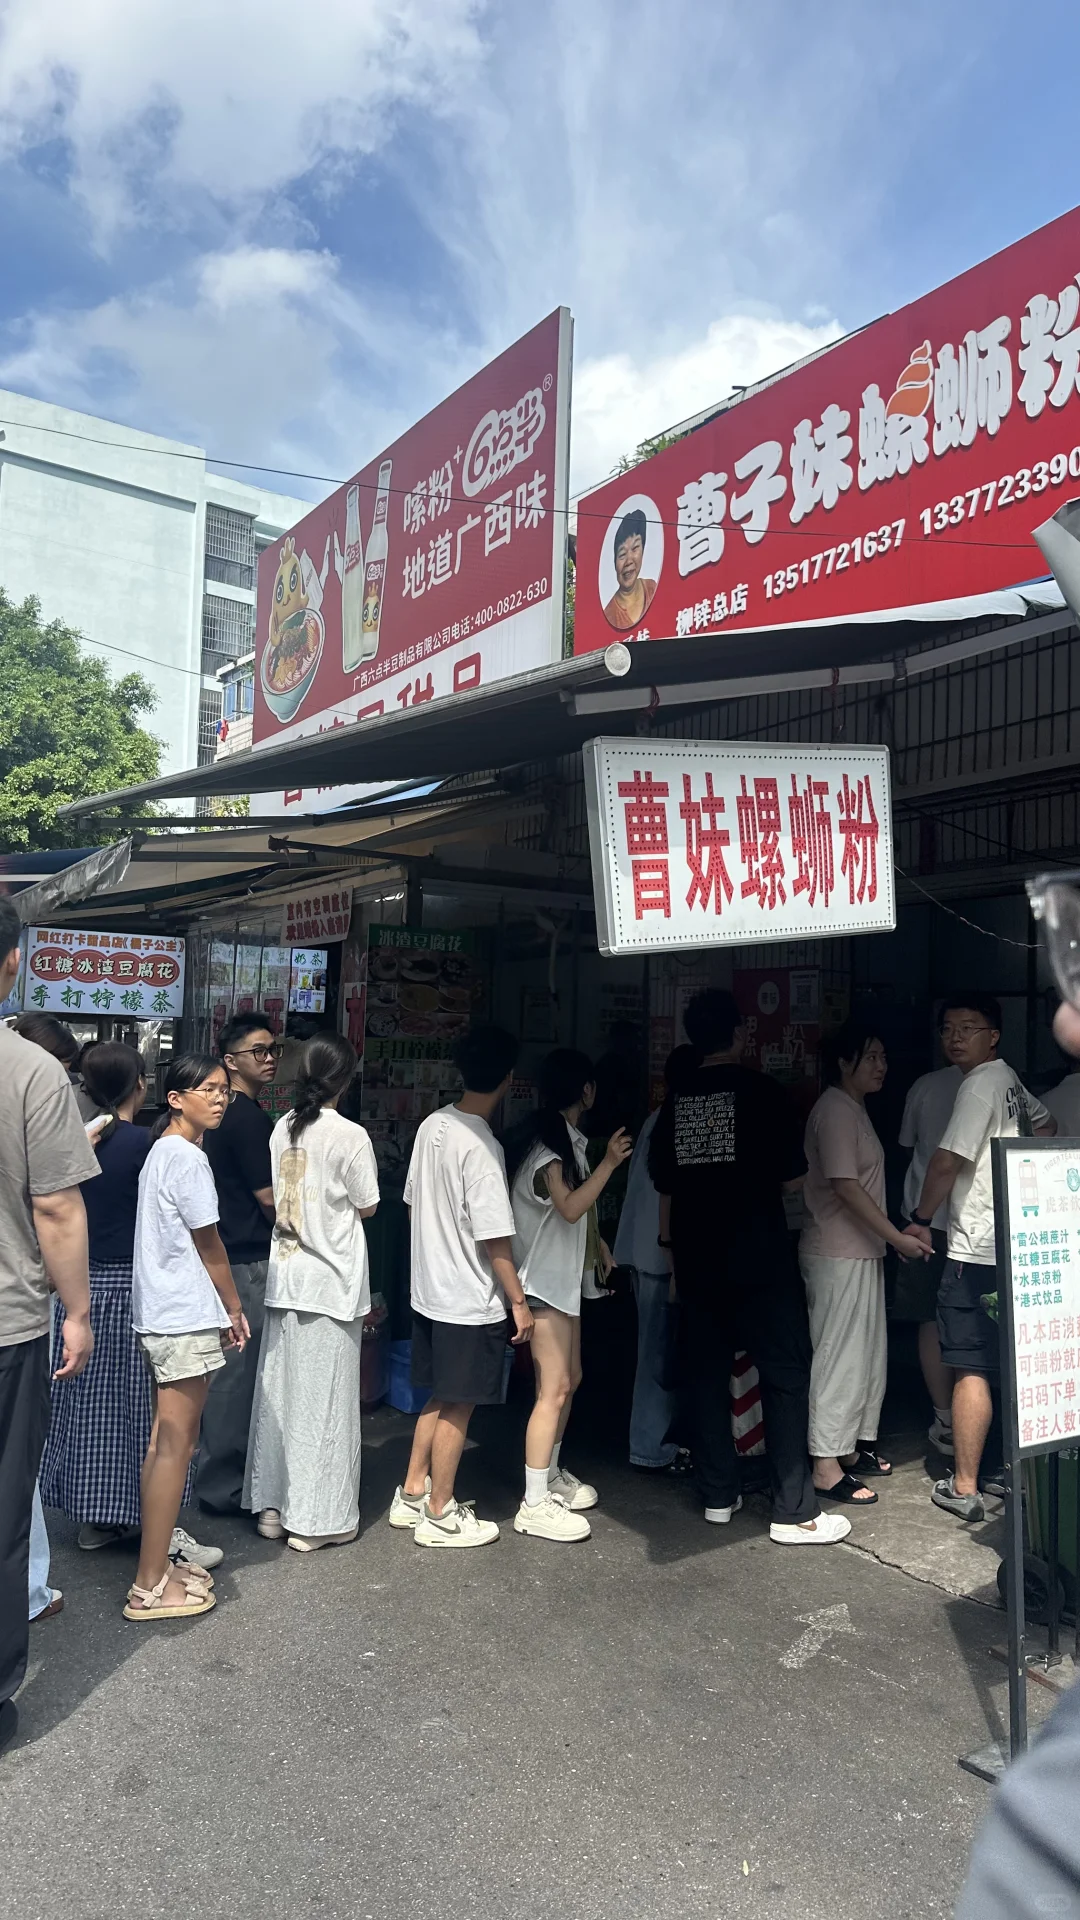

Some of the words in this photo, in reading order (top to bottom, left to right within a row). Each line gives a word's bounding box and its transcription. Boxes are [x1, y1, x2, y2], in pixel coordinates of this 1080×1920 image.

[402, 470, 547, 599] 地道广西味
[763, 518, 906, 598] 13517721637
[919, 446, 1080, 535] 1337723390
[618, 770, 879, 920] 曹妹螺蛳粉
[34, 954, 175, 979] 红糖冰渣豆腐花
[294, 952, 323, 967] 奶茶
[31, 984, 175, 1013] 手打柠檬茶
[1018, 1249, 1070, 1266] 红糖豆腐花
[1019, 1269, 1061, 1287] 水果凉粉
[1020, 1289, 1062, 1307] 港式饮品
[1017, 1315, 1080, 1345] 凡本店消
[1020, 1378, 1076, 1410] 扫码下单
[1021, 1409, 1080, 1442] 备注人数
